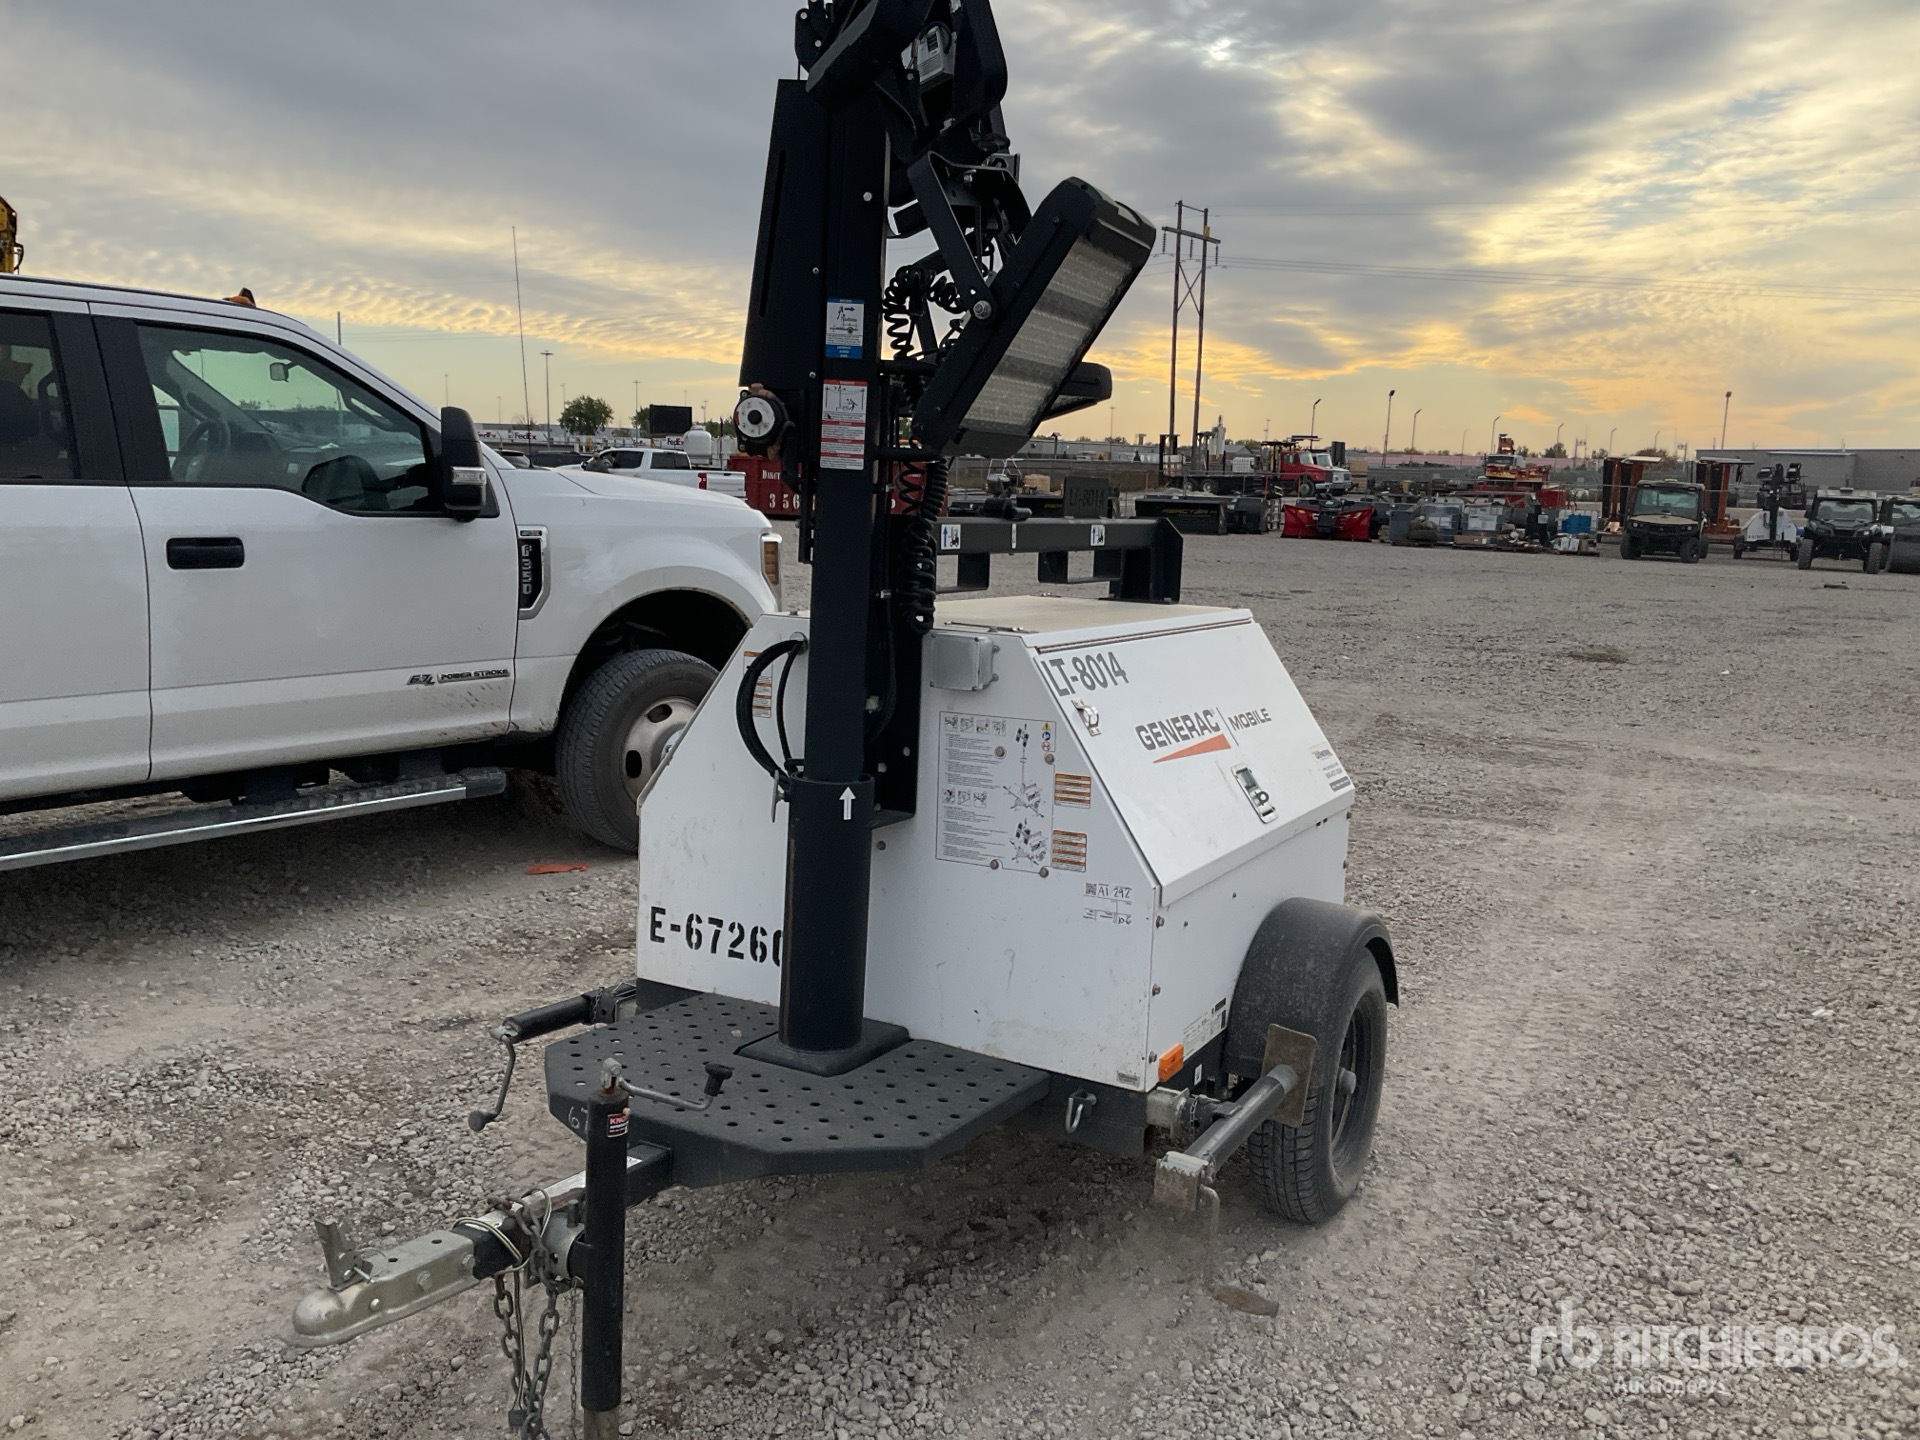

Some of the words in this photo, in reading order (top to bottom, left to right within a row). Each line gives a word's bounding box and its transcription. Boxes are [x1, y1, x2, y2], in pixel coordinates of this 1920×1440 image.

[440, 671, 472, 680] POWER
[474, 669, 509, 679] STROKE
[1040, 651, 1129, 697] LT-8014
[1135, 709, 1221, 751] GENERAC
[1228, 708, 1272, 732] MOBILE
